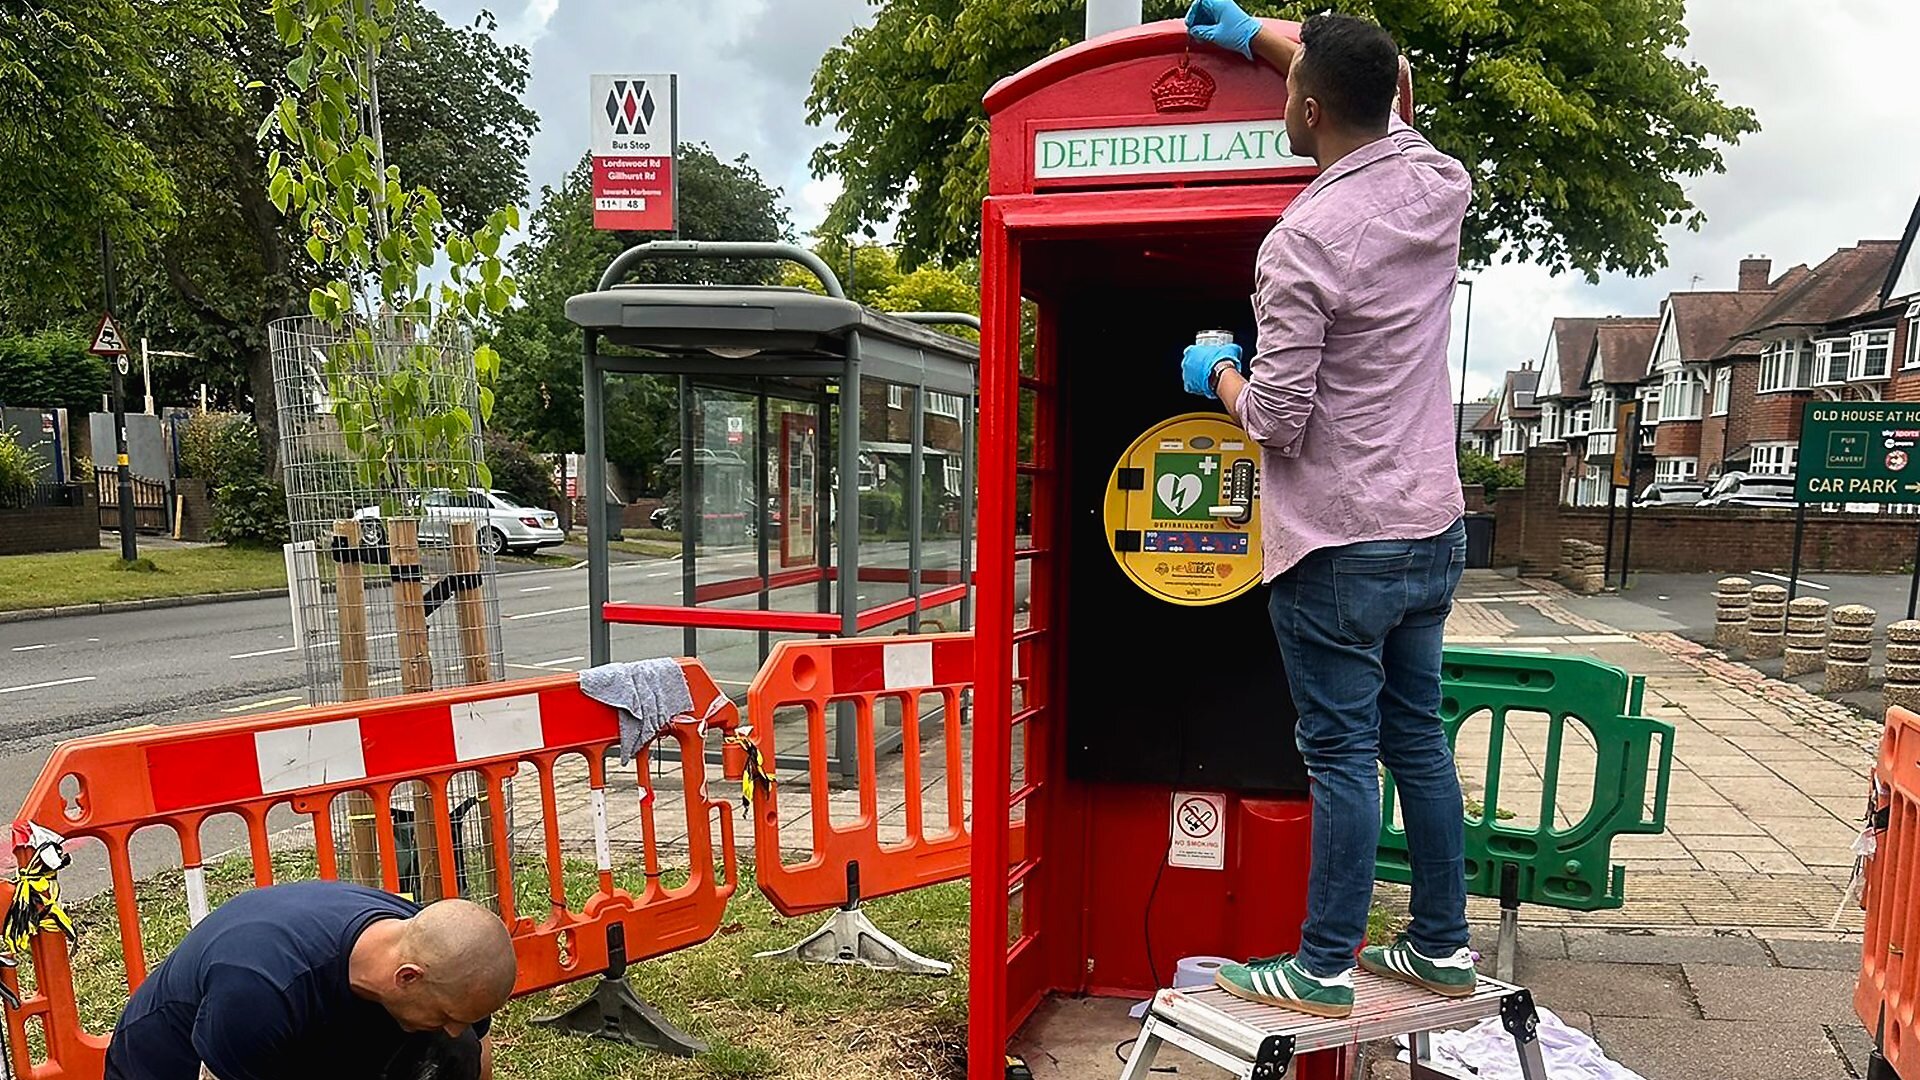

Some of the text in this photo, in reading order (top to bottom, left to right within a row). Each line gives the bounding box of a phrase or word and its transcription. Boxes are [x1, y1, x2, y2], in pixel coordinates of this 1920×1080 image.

[612, 140, 651, 150] Bus Stop
[1041, 129, 1294, 169] DEFIBRILLATO
[602, 159, 661, 168] Lordswood Rd
[644, 171, 656, 180] Rd
[627, 200, 639, 208] 48
[1813, 410, 1838, 421] OLD
[1841, 410, 1884, 421] HOUSE
[1886, 411, 1903, 421] AT
[1809, 478, 1898, 493] CAR PARK
[1187, 840, 1219, 848] SMOKING
